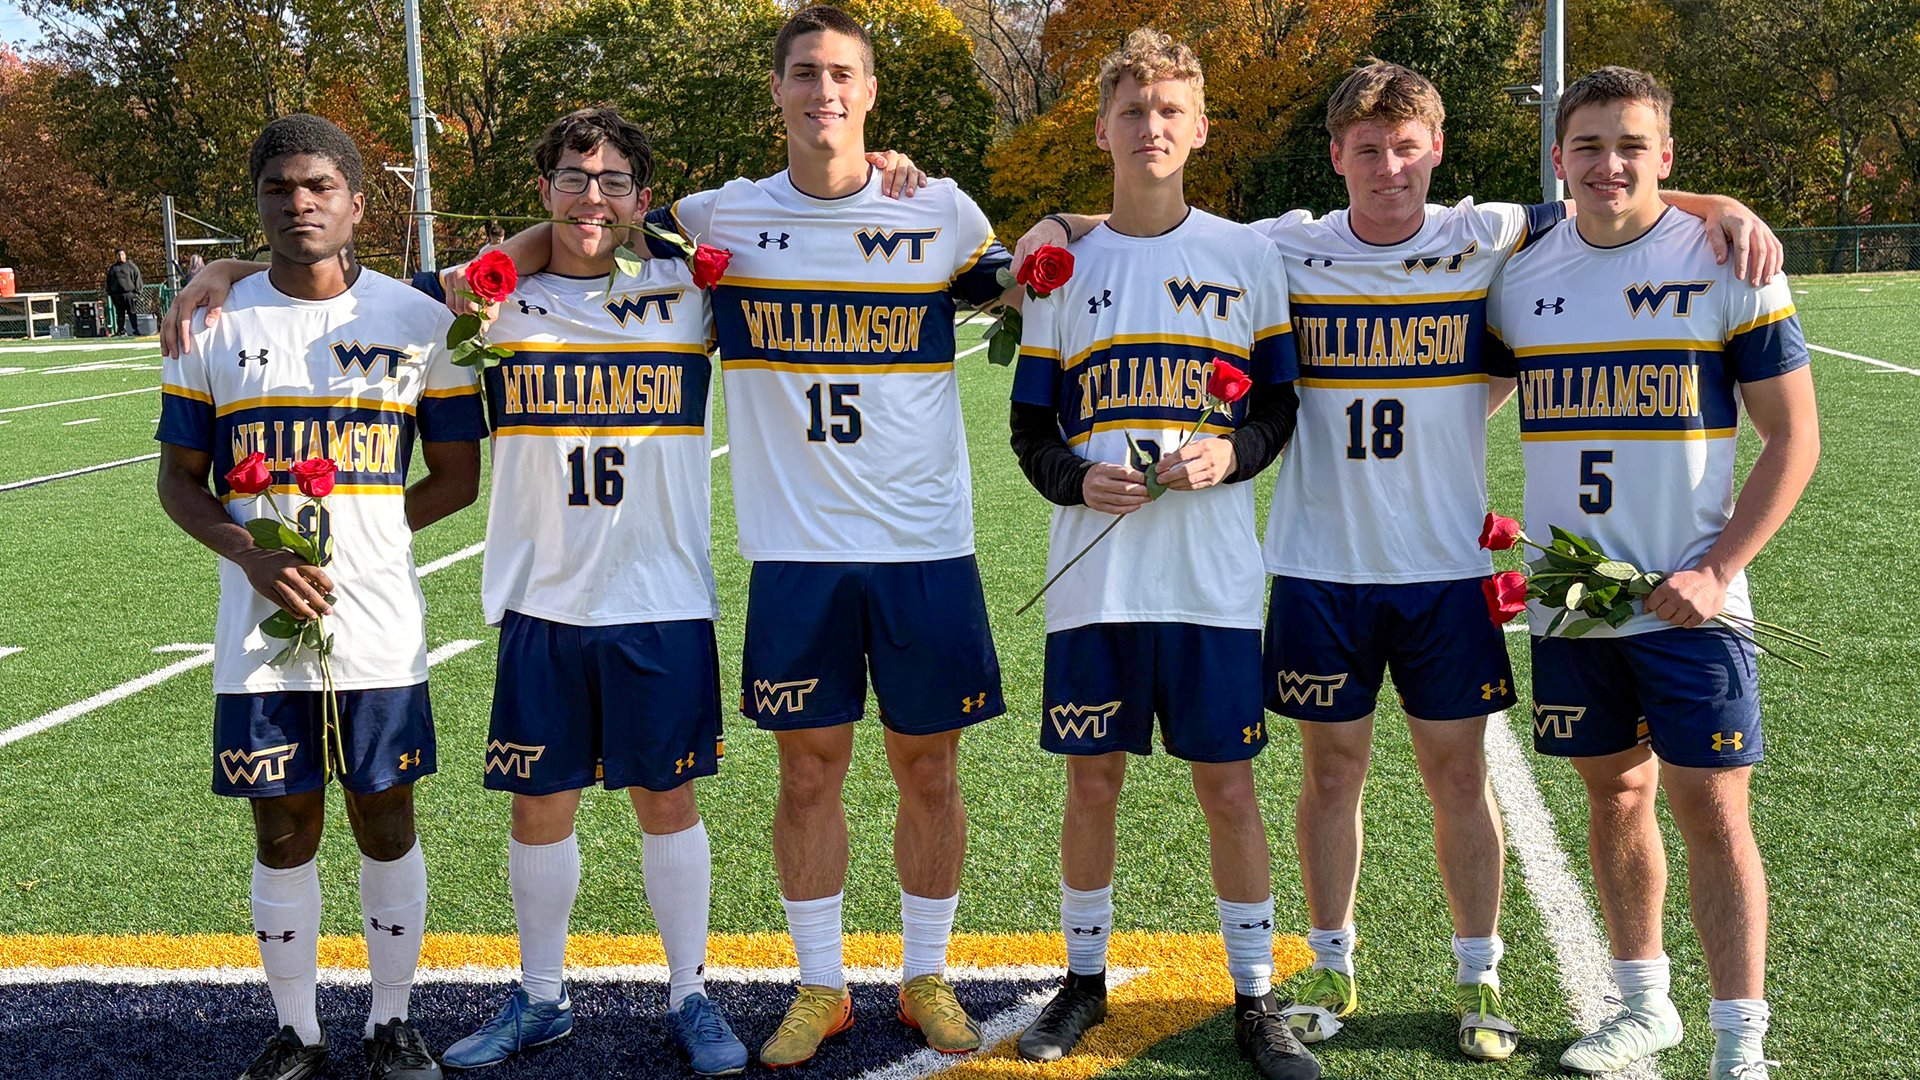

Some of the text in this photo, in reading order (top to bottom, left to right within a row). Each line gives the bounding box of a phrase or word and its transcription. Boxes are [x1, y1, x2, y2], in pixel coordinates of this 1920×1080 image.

[853, 226, 942, 264] WT
[603, 288, 685, 330] WT
[1164, 275, 1247, 321] WT
[1622, 280, 1716, 320] WT
[740, 300, 928, 353] WILLIAMSON
[1293, 314, 1470, 367] WILLIAMSON
[329, 339, 421, 382] WT
[502, 365, 683, 415] WILLIAMSON
[1078, 357, 1233, 420] WILLIAMSO
[1520, 364, 1700, 420] WILLIAMSON
[805, 381, 863, 444] 15
[1345, 397, 1405, 461] 18
[567, 445, 626, 508] 16
[1578, 449, 1615, 515] 5
[753, 678, 819, 715] WT
[1278, 670, 1349, 706] WT
[1050, 701, 1122, 740] WT
[219, 742, 299, 785] WT
[485, 739, 546, 778] WT
